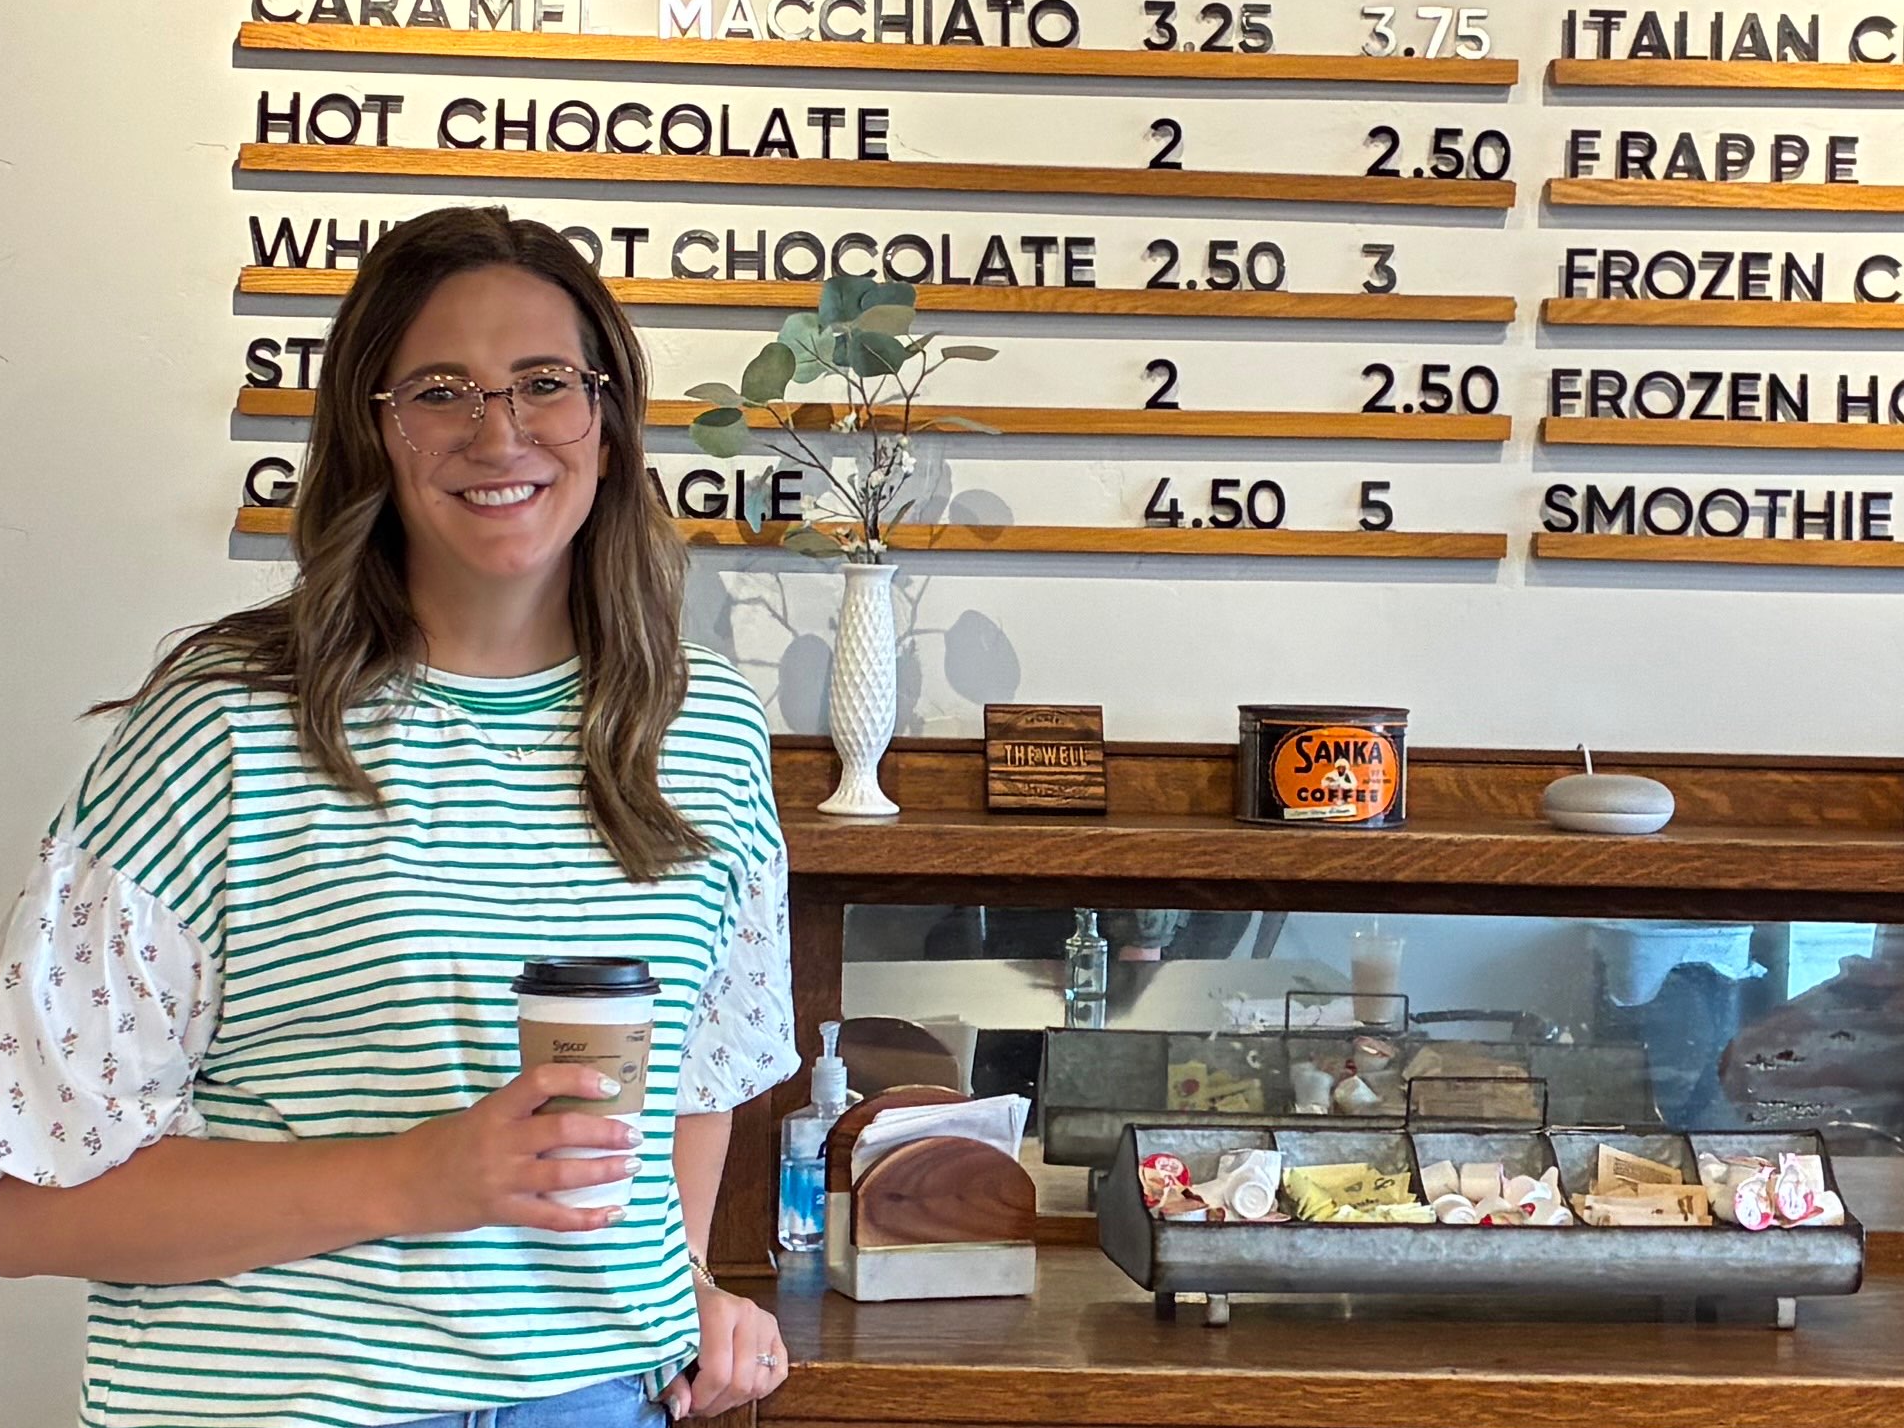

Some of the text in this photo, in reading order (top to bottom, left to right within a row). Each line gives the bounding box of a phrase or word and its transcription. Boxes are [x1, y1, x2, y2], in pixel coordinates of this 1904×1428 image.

[1143, 0, 1274, 53] 3.25
[1361, 5, 1492, 60] 3.75
[1562, 9, 1820, 63] ITALIAN
[257, 90, 1512, 179] HOT CHOCOLATE 2 2.50
[1565, 129, 1861, 185] FRAPPE
[671, 228, 1096, 288] CHOCOLATE
[1146, 239, 1286, 291] 2.50
[1361, 243, 1397, 294] 3
[1559, 248, 1824, 302] FROZEN
[1145, 359, 1179, 410] 2
[1361, 363, 1499, 414] 2.50
[1547, 368, 1809, 422] FROZEN
[1144, 478, 1286, 530] 4.50
[1360, 480, 1394, 531] 5
[1543, 483, 1895, 541] SMOOTHIE
[1293, 735, 1383, 774] SANKA
[1296, 786, 1380, 804] COFFEE
